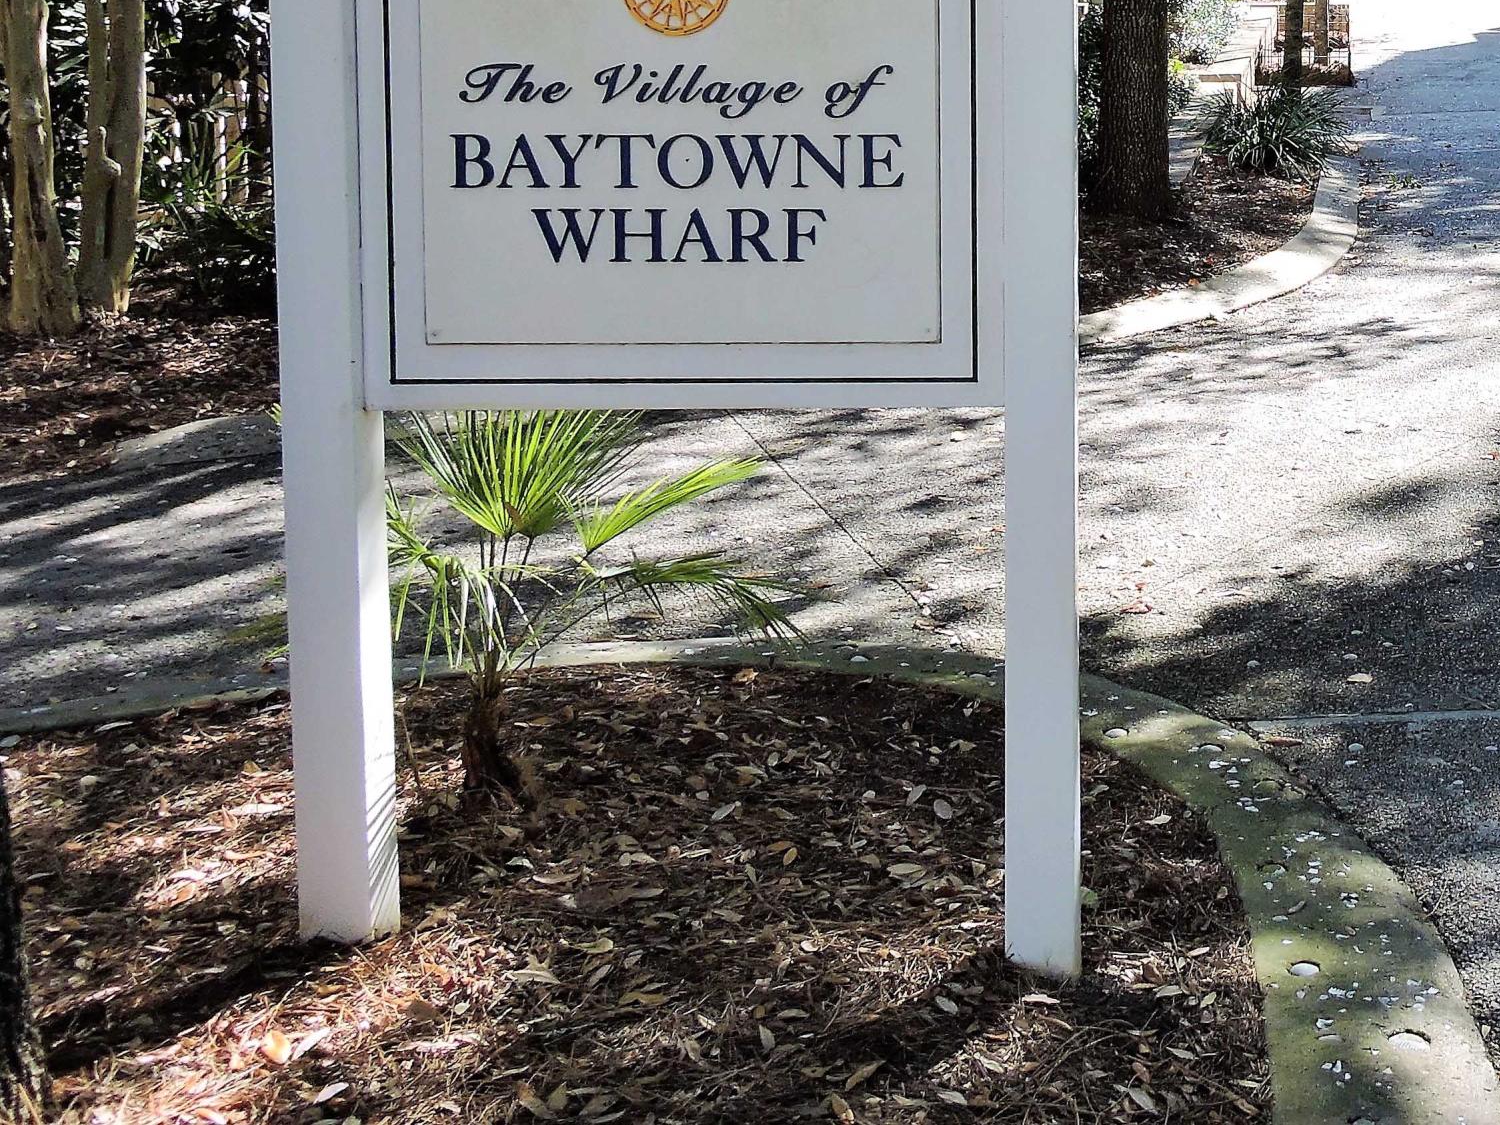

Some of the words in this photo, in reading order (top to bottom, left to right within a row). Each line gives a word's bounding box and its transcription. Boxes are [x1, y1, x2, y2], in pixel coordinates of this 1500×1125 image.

[457, 62, 574, 105] The
[593, 62, 805, 119] Village
[823, 63, 895, 119] of
[448, 132, 906, 191] BAYTOWNE
[529, 206, 828, 265] WHARF
